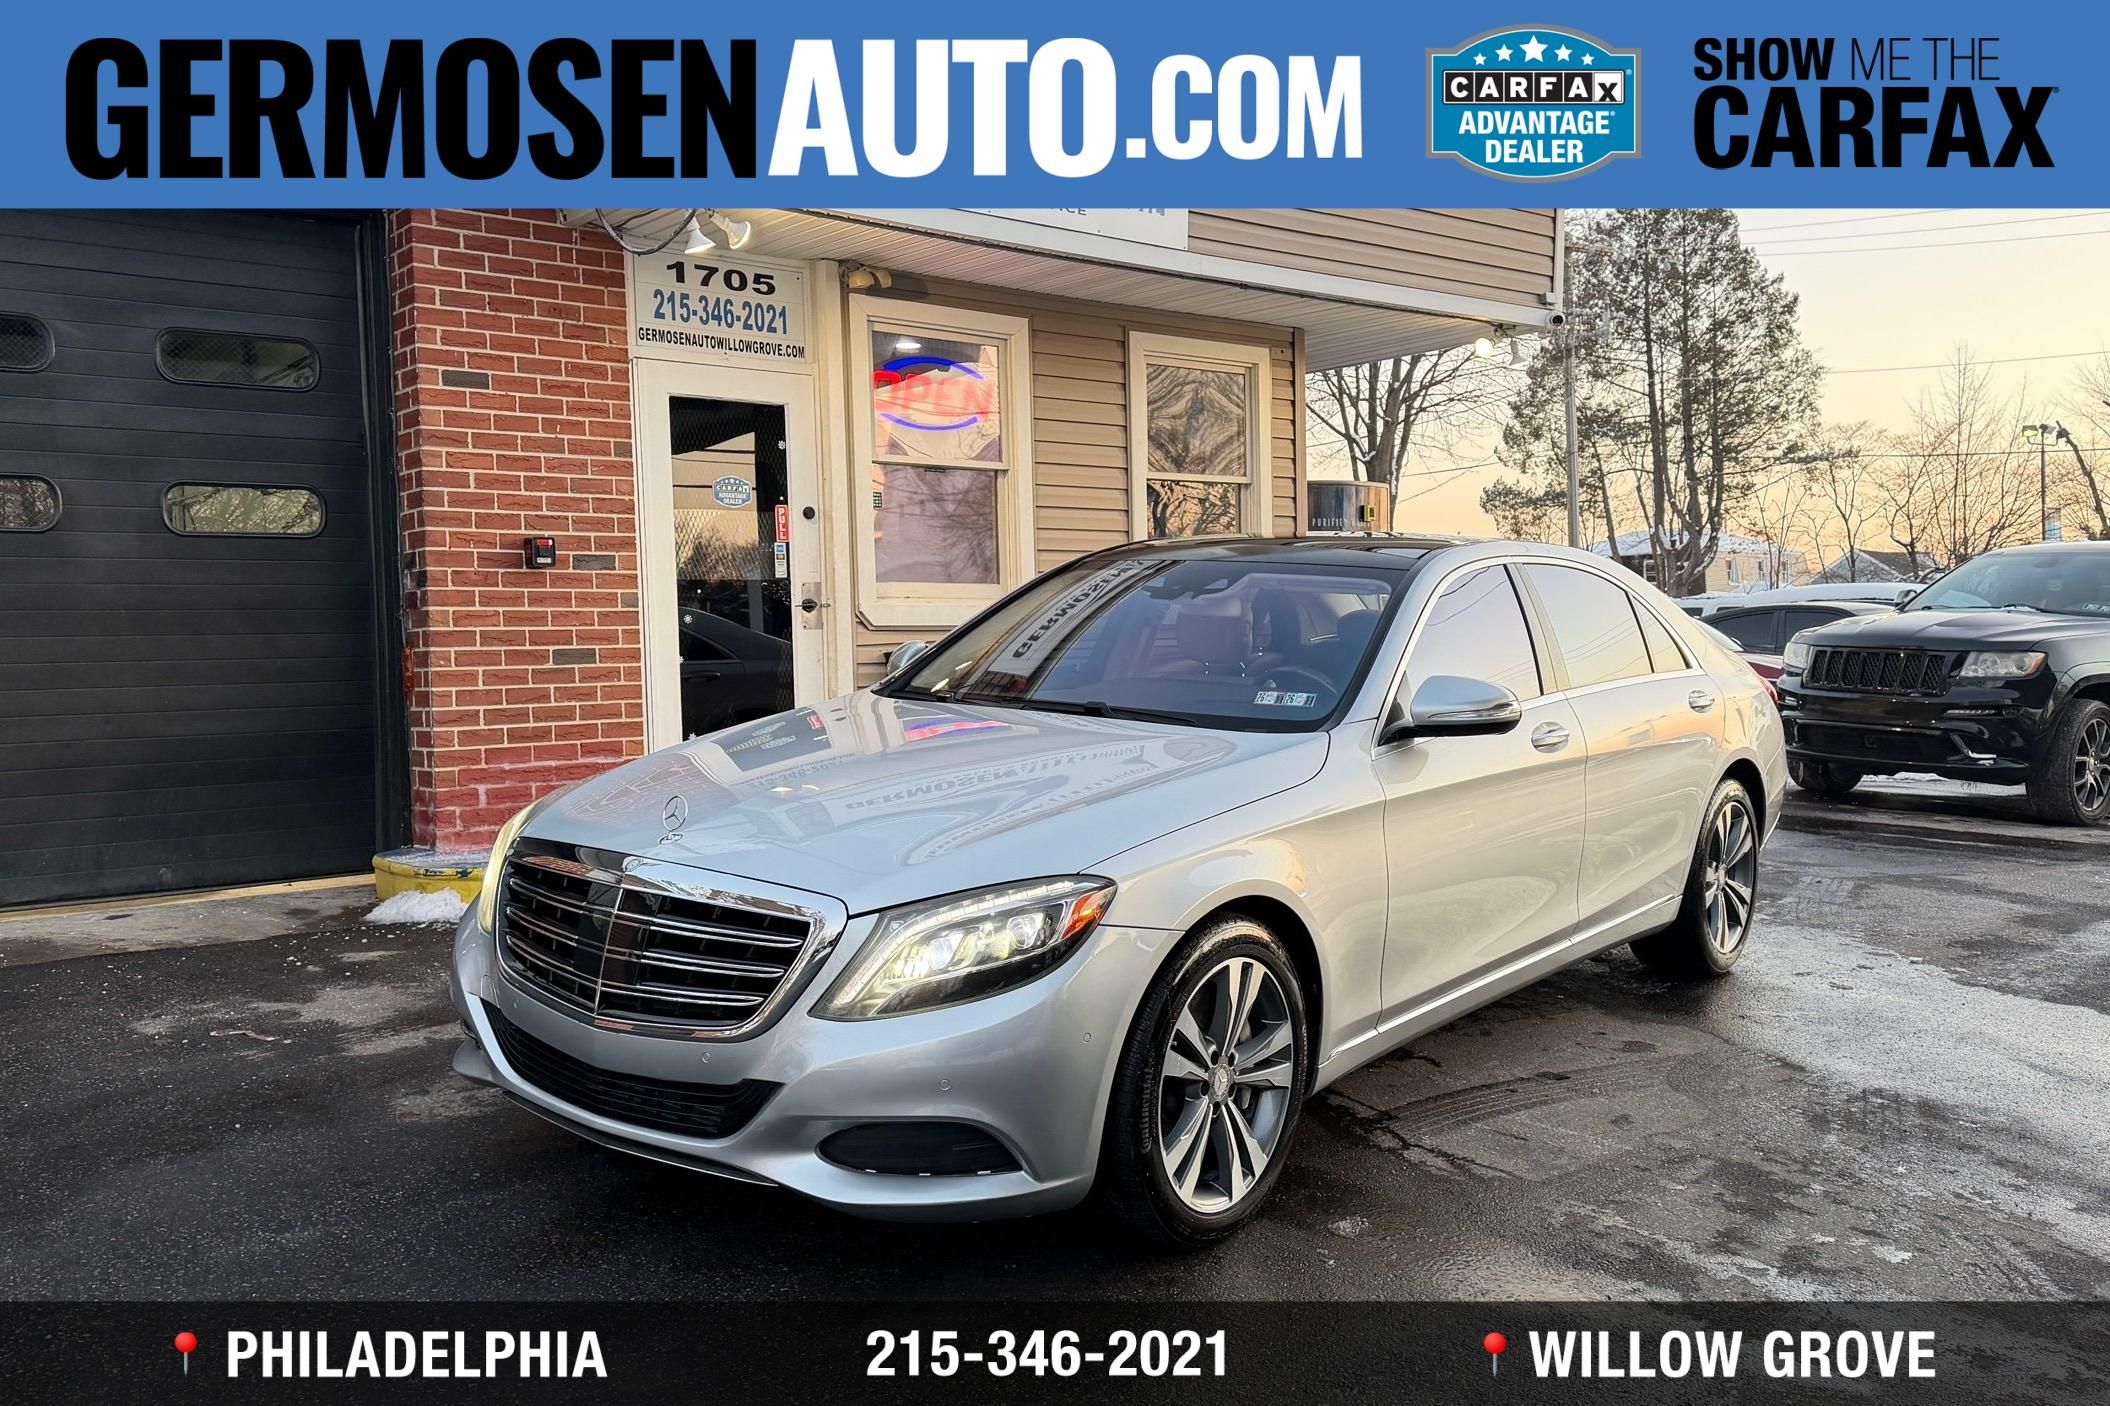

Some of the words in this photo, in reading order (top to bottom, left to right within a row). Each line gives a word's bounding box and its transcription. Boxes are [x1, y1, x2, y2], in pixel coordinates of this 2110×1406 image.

[666, 260, 776, 296] 1705
[653, 288, 788, 335] 215-346-2021
[638, 326, 806, 359] GERMOSENAUTOWILLOWGROVE.COM
[873, 368, 994, 423] OPEN
[778, 507, 787, 540] PULL
